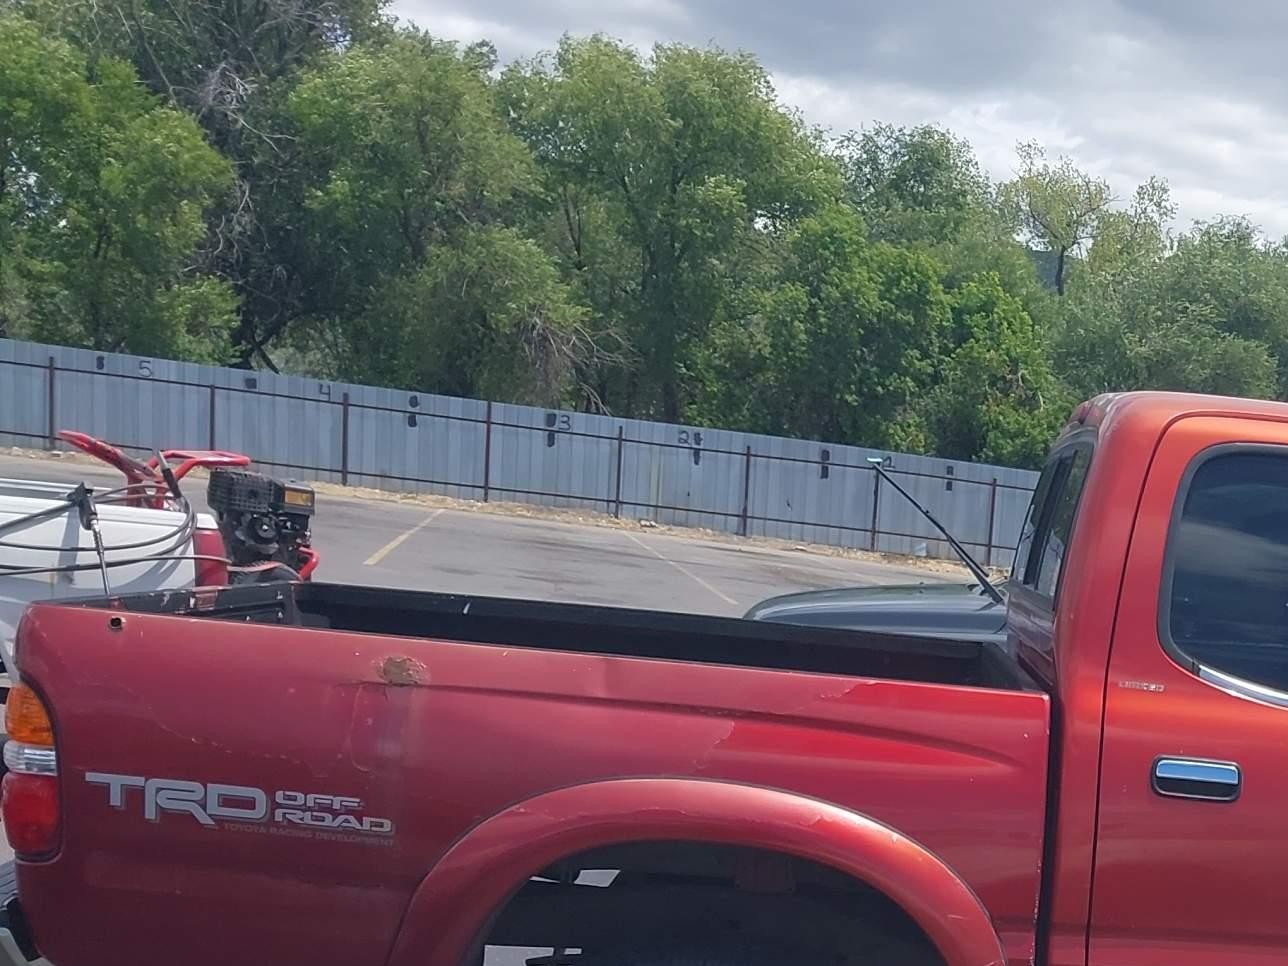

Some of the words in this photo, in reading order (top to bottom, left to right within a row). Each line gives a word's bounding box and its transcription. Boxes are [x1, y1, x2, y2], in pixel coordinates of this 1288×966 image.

[139, 360, 153, 378] 5
[319, 384, 331, 401] 4
[557, 415, 571, 431] 3
[678, 431, 690, 445] 2
[85, 772, 268, 825] TRD
[274, 790, 361, 810] OFF
[274, 808, 393, 833] ROAD
[223, 823, 267, 834] TOYOTA
[270, 827, 313, 839] RACING
